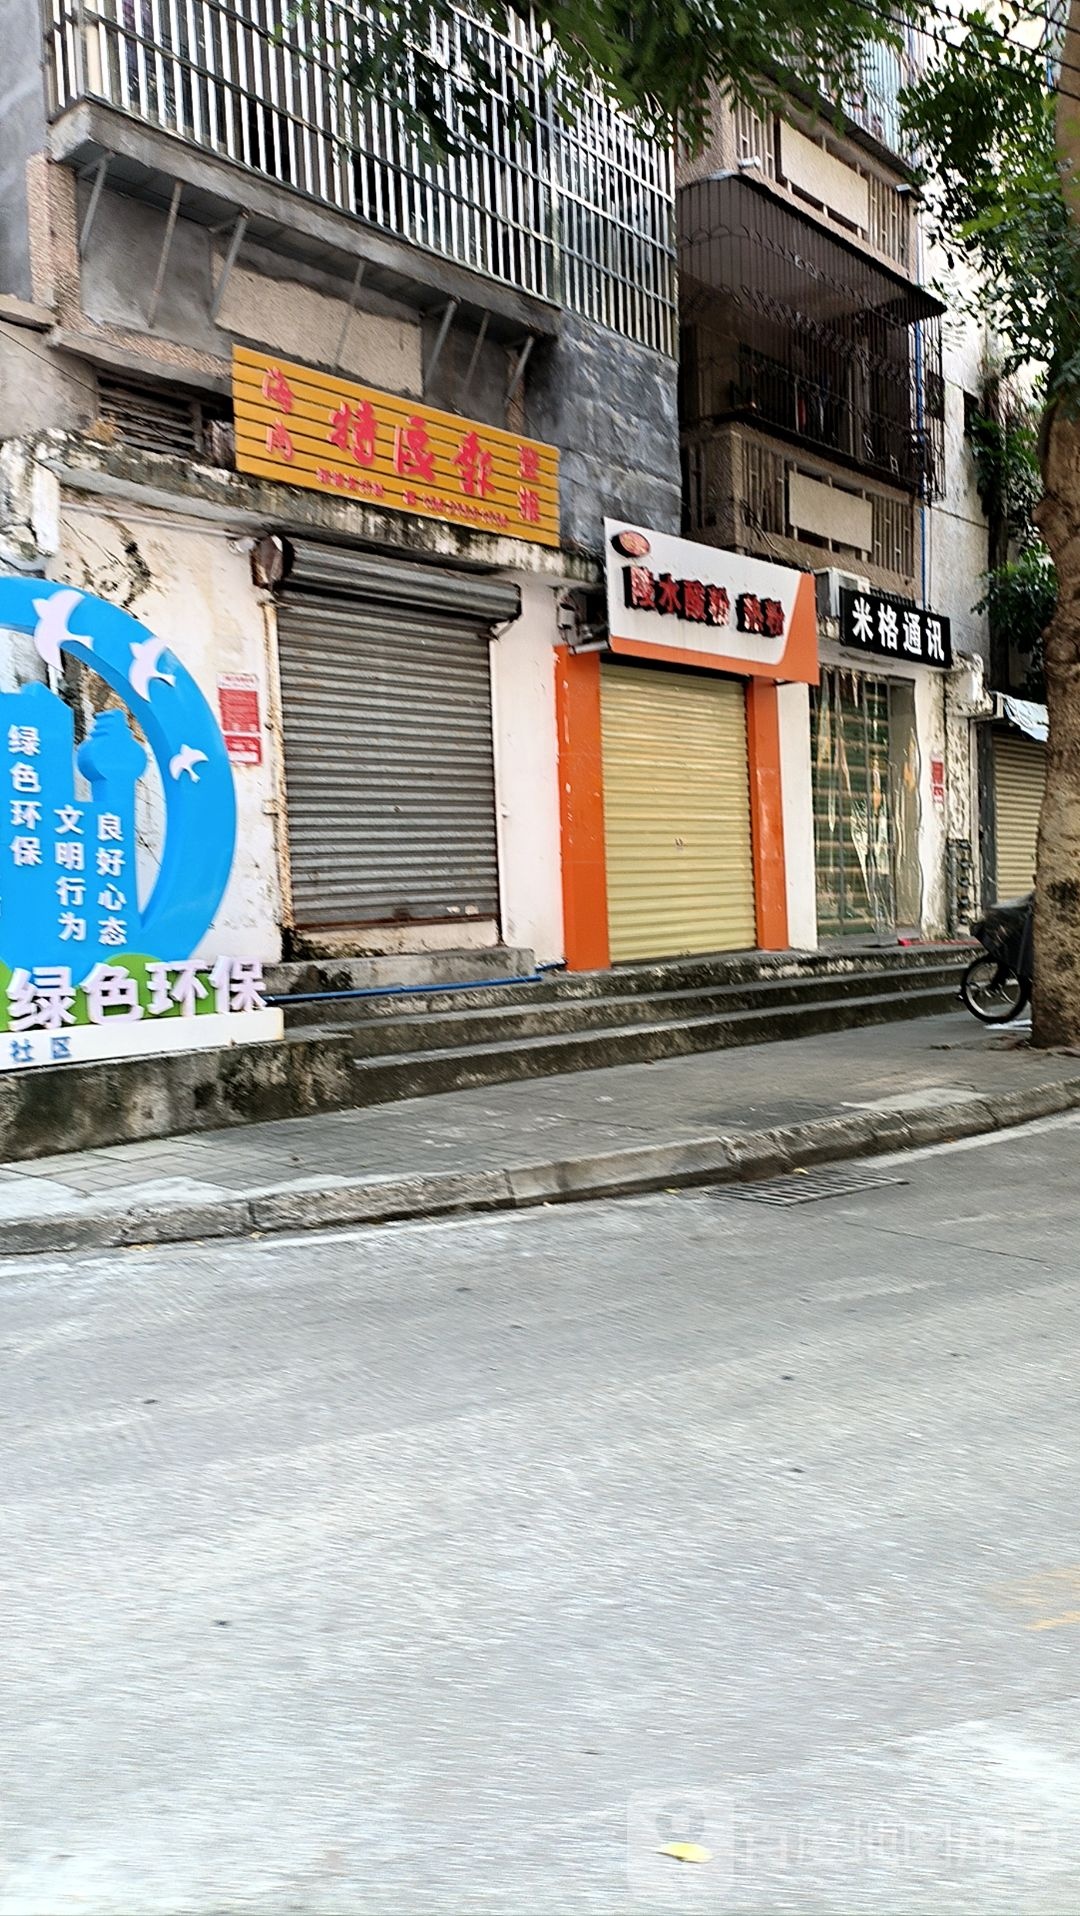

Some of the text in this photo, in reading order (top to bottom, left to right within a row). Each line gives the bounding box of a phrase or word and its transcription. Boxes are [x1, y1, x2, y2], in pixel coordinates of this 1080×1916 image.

[852, 596, 945, 661] 米格通讯
[8, 724, 43, 867] 绿色环保
[54, 804, 88, 942] 文明行为
[95, 812, 128, 946] 良好心态
[6, 955, 268, 1032] 绿色环保
[9, 1036, 72, 1063] 社区
